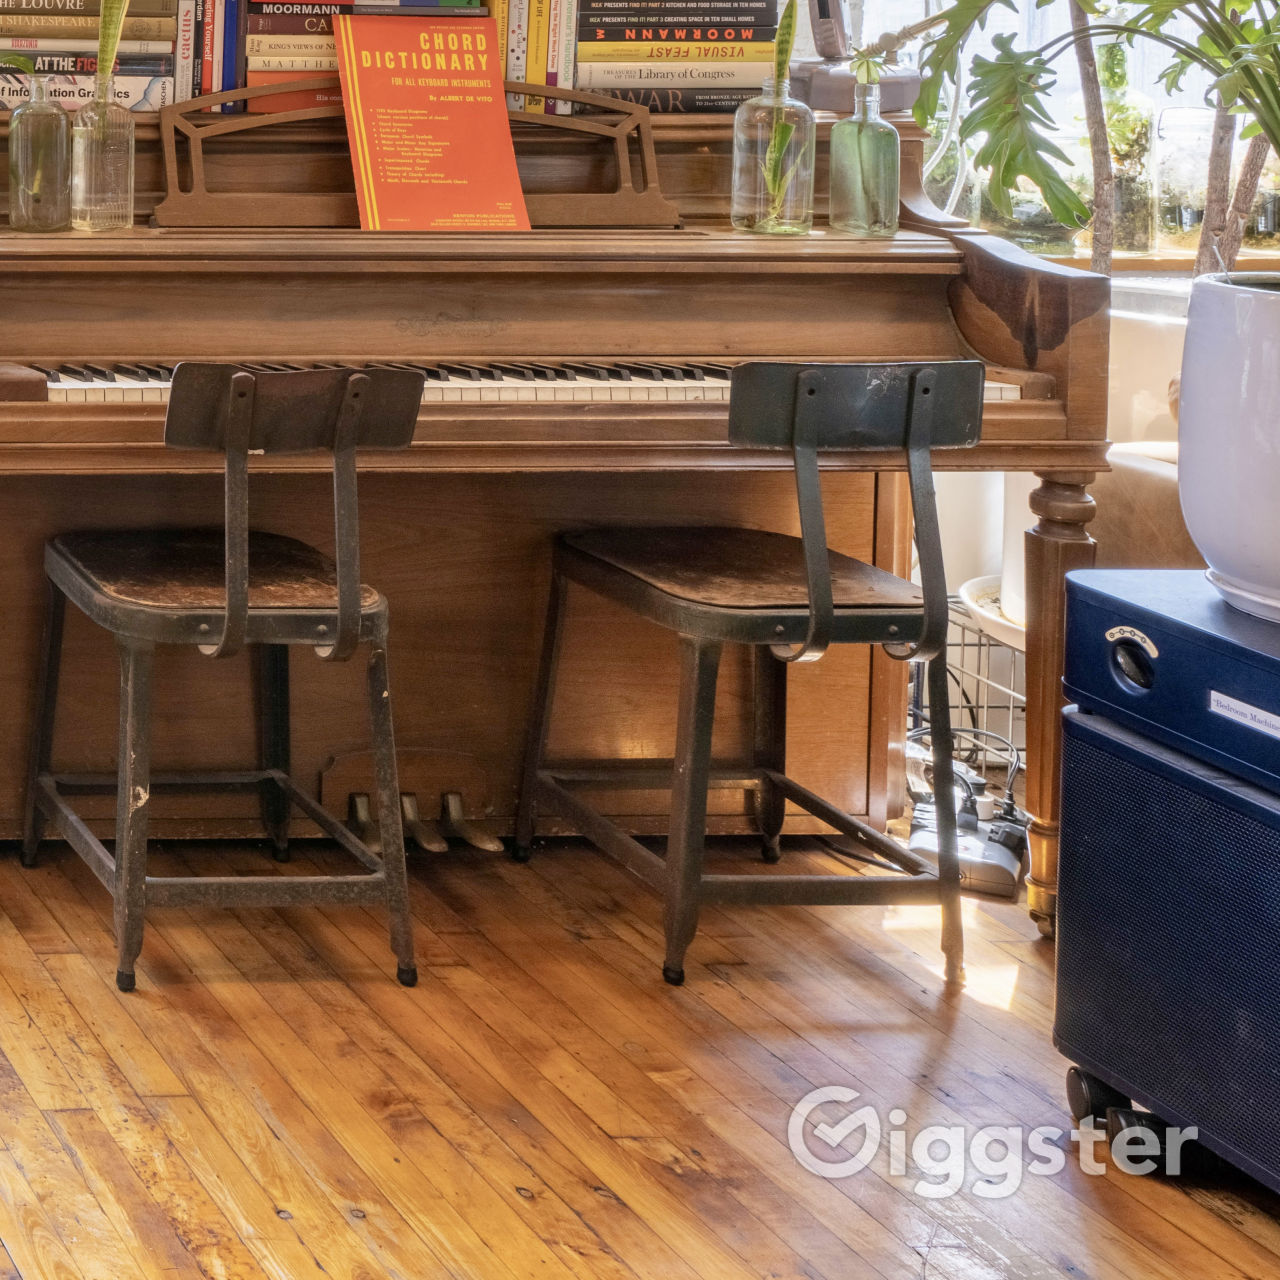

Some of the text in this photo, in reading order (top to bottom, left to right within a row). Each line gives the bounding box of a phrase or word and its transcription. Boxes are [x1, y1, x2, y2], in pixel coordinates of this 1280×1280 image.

[262, 4, 340, 15] MOORMANN
[181, 9, 191, 60] cactus
[625, 29, 754, 40] MOORMANN
[204, 25, 213, 61] Yourself
[420, 32, 487, 51] CHORD
[646, 46, 690, 57] FEAST
[697, 47, 745, 57] VISUAL
[35, 57, 48, 70] AT
[48, 57, 76, 71] THE
[77, 58, 119, 71] FIGS
[262, 60, 335, 68] MATTHE
[361, 51, 488, 71] DICTIONARY
[639, 69, 735, 80] Library of Congress
[392, 77, 492, 88] FOR ALL KEYBOARD INSTRUMENTS
[1216, 700, 1248, 718] Bedroom
